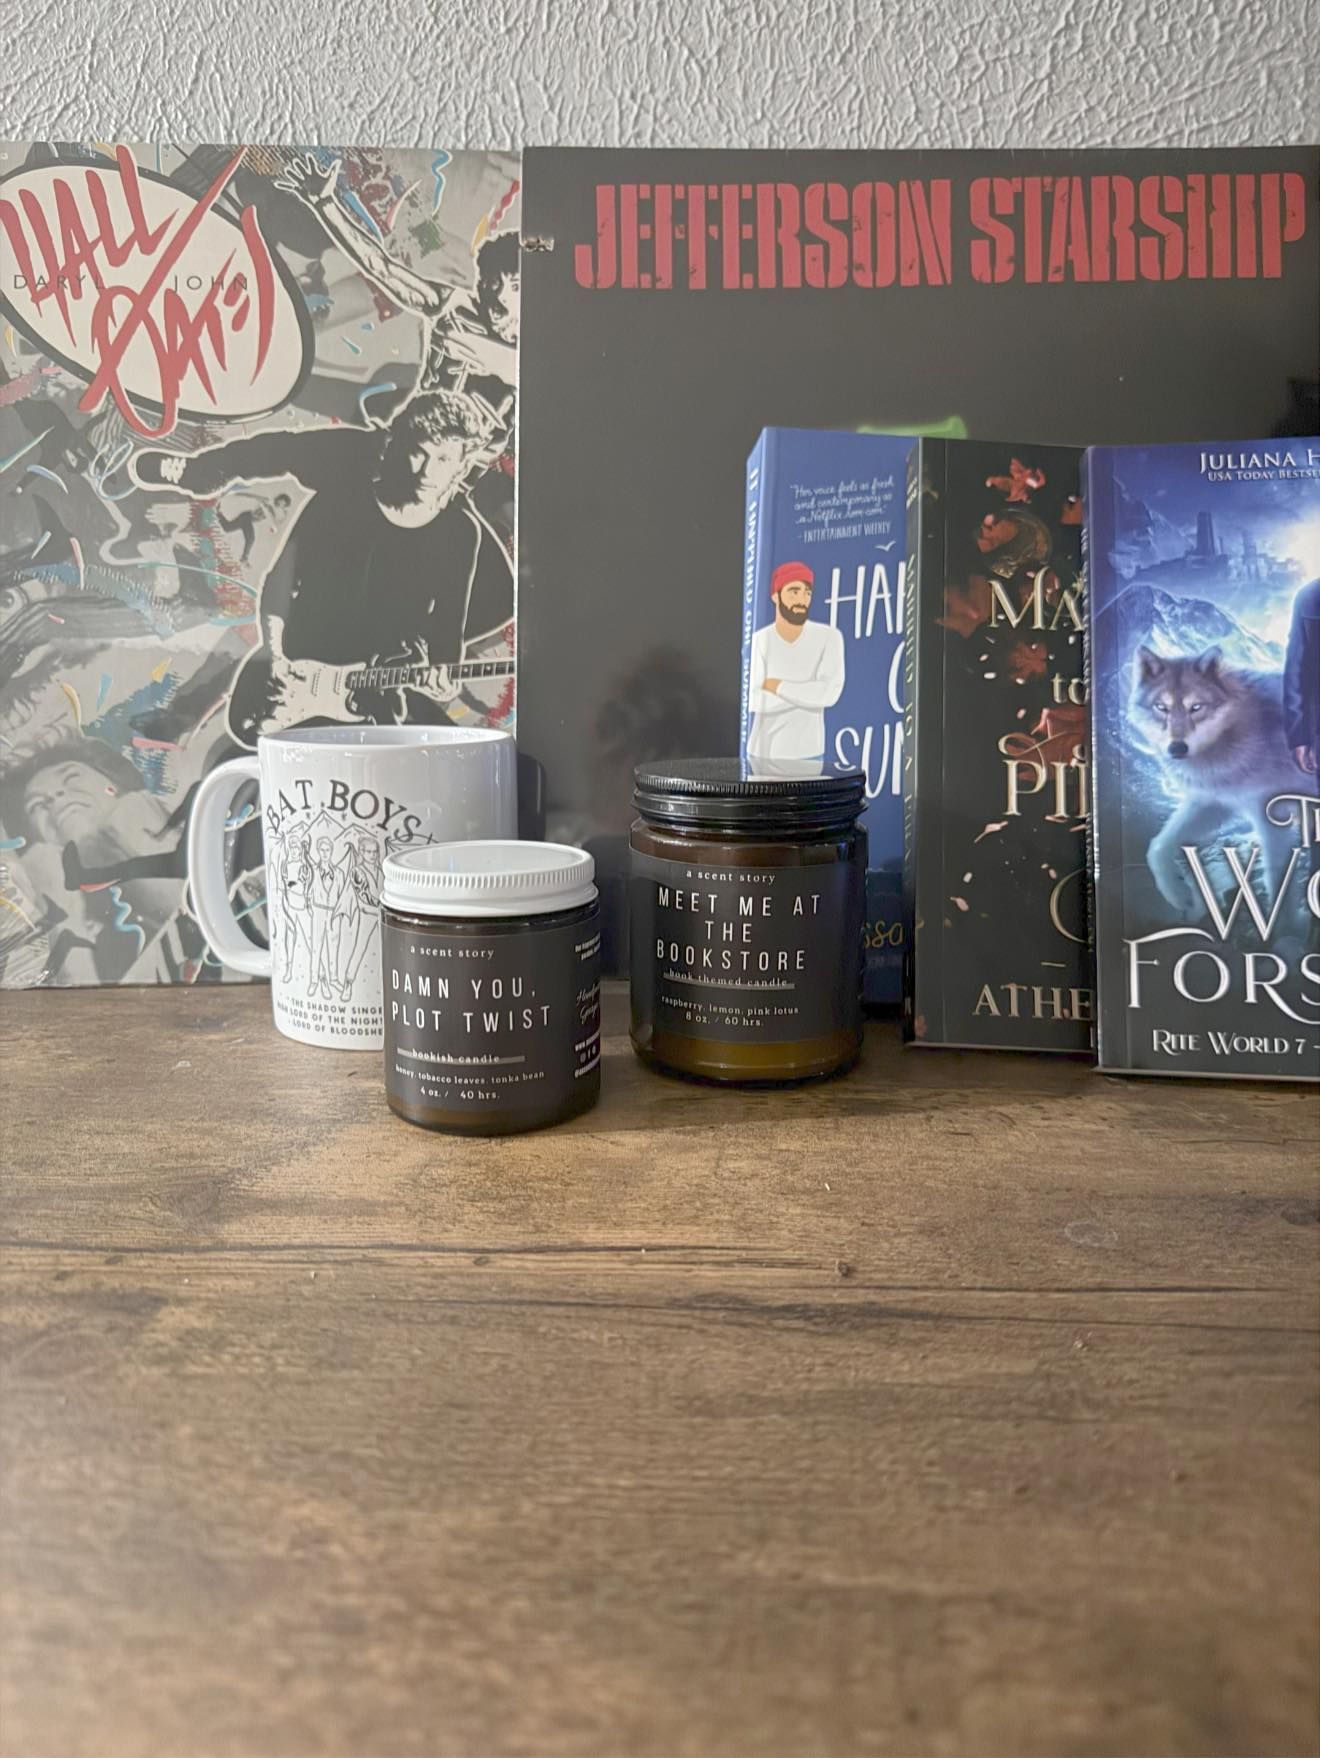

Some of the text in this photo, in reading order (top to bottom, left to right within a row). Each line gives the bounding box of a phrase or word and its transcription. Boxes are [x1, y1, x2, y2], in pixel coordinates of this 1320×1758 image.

[574, 172, 1306, 290] JEFFERSON STARSHIP
[0, 144, 180, 349] HALL
[13, 274, 250, 292] DARYL JOHN
[1200, 452, 1297, 474] JULIANA
[1208, 471, 1232, 481] USA
[1236, 470, 1275, 480] TODAY
[267, 779, 422, 842] BAT BOYS
[686, 869, 776, 885] a scent story
[658, 886, 821, 917] MEET ME AT
[704, 920, 752, 943] THE
[410, 945, 495, 959] a scent story
[656, 939, 805, 971] BOOKSTORE
[391, 968, 537, 999] DAMN YOU,
[669, 967, 788, 987] book themed candle
[290, 1008, 308, 1019] LORD
[328, 1015, 346, 1024] THE
[307, 1001, 347, 1014] SHADOW
[747, 1006, 771, 1016] pink
[774, 1006, 799, 1015] lotus
[293, 1019, 311, 1030] LORD
[315, 1024, 325, 1032] OF
[391, 1001, 551, 1033] PLOT TWIST
[685, 1011, 692, 1021] 8
[724, 1016, 739, 1026] 60
[1152, 1029, 1306, 1056] RITE WORLD 7
[412, 1048, 500, 1063] bookish candle
[418, 1072, 452, 1084] tobacco
[491, 1074, 520, 1084] tonka
[522, 1070, 545, 1081] bean
[460, 1090, 474, 1099] 40
